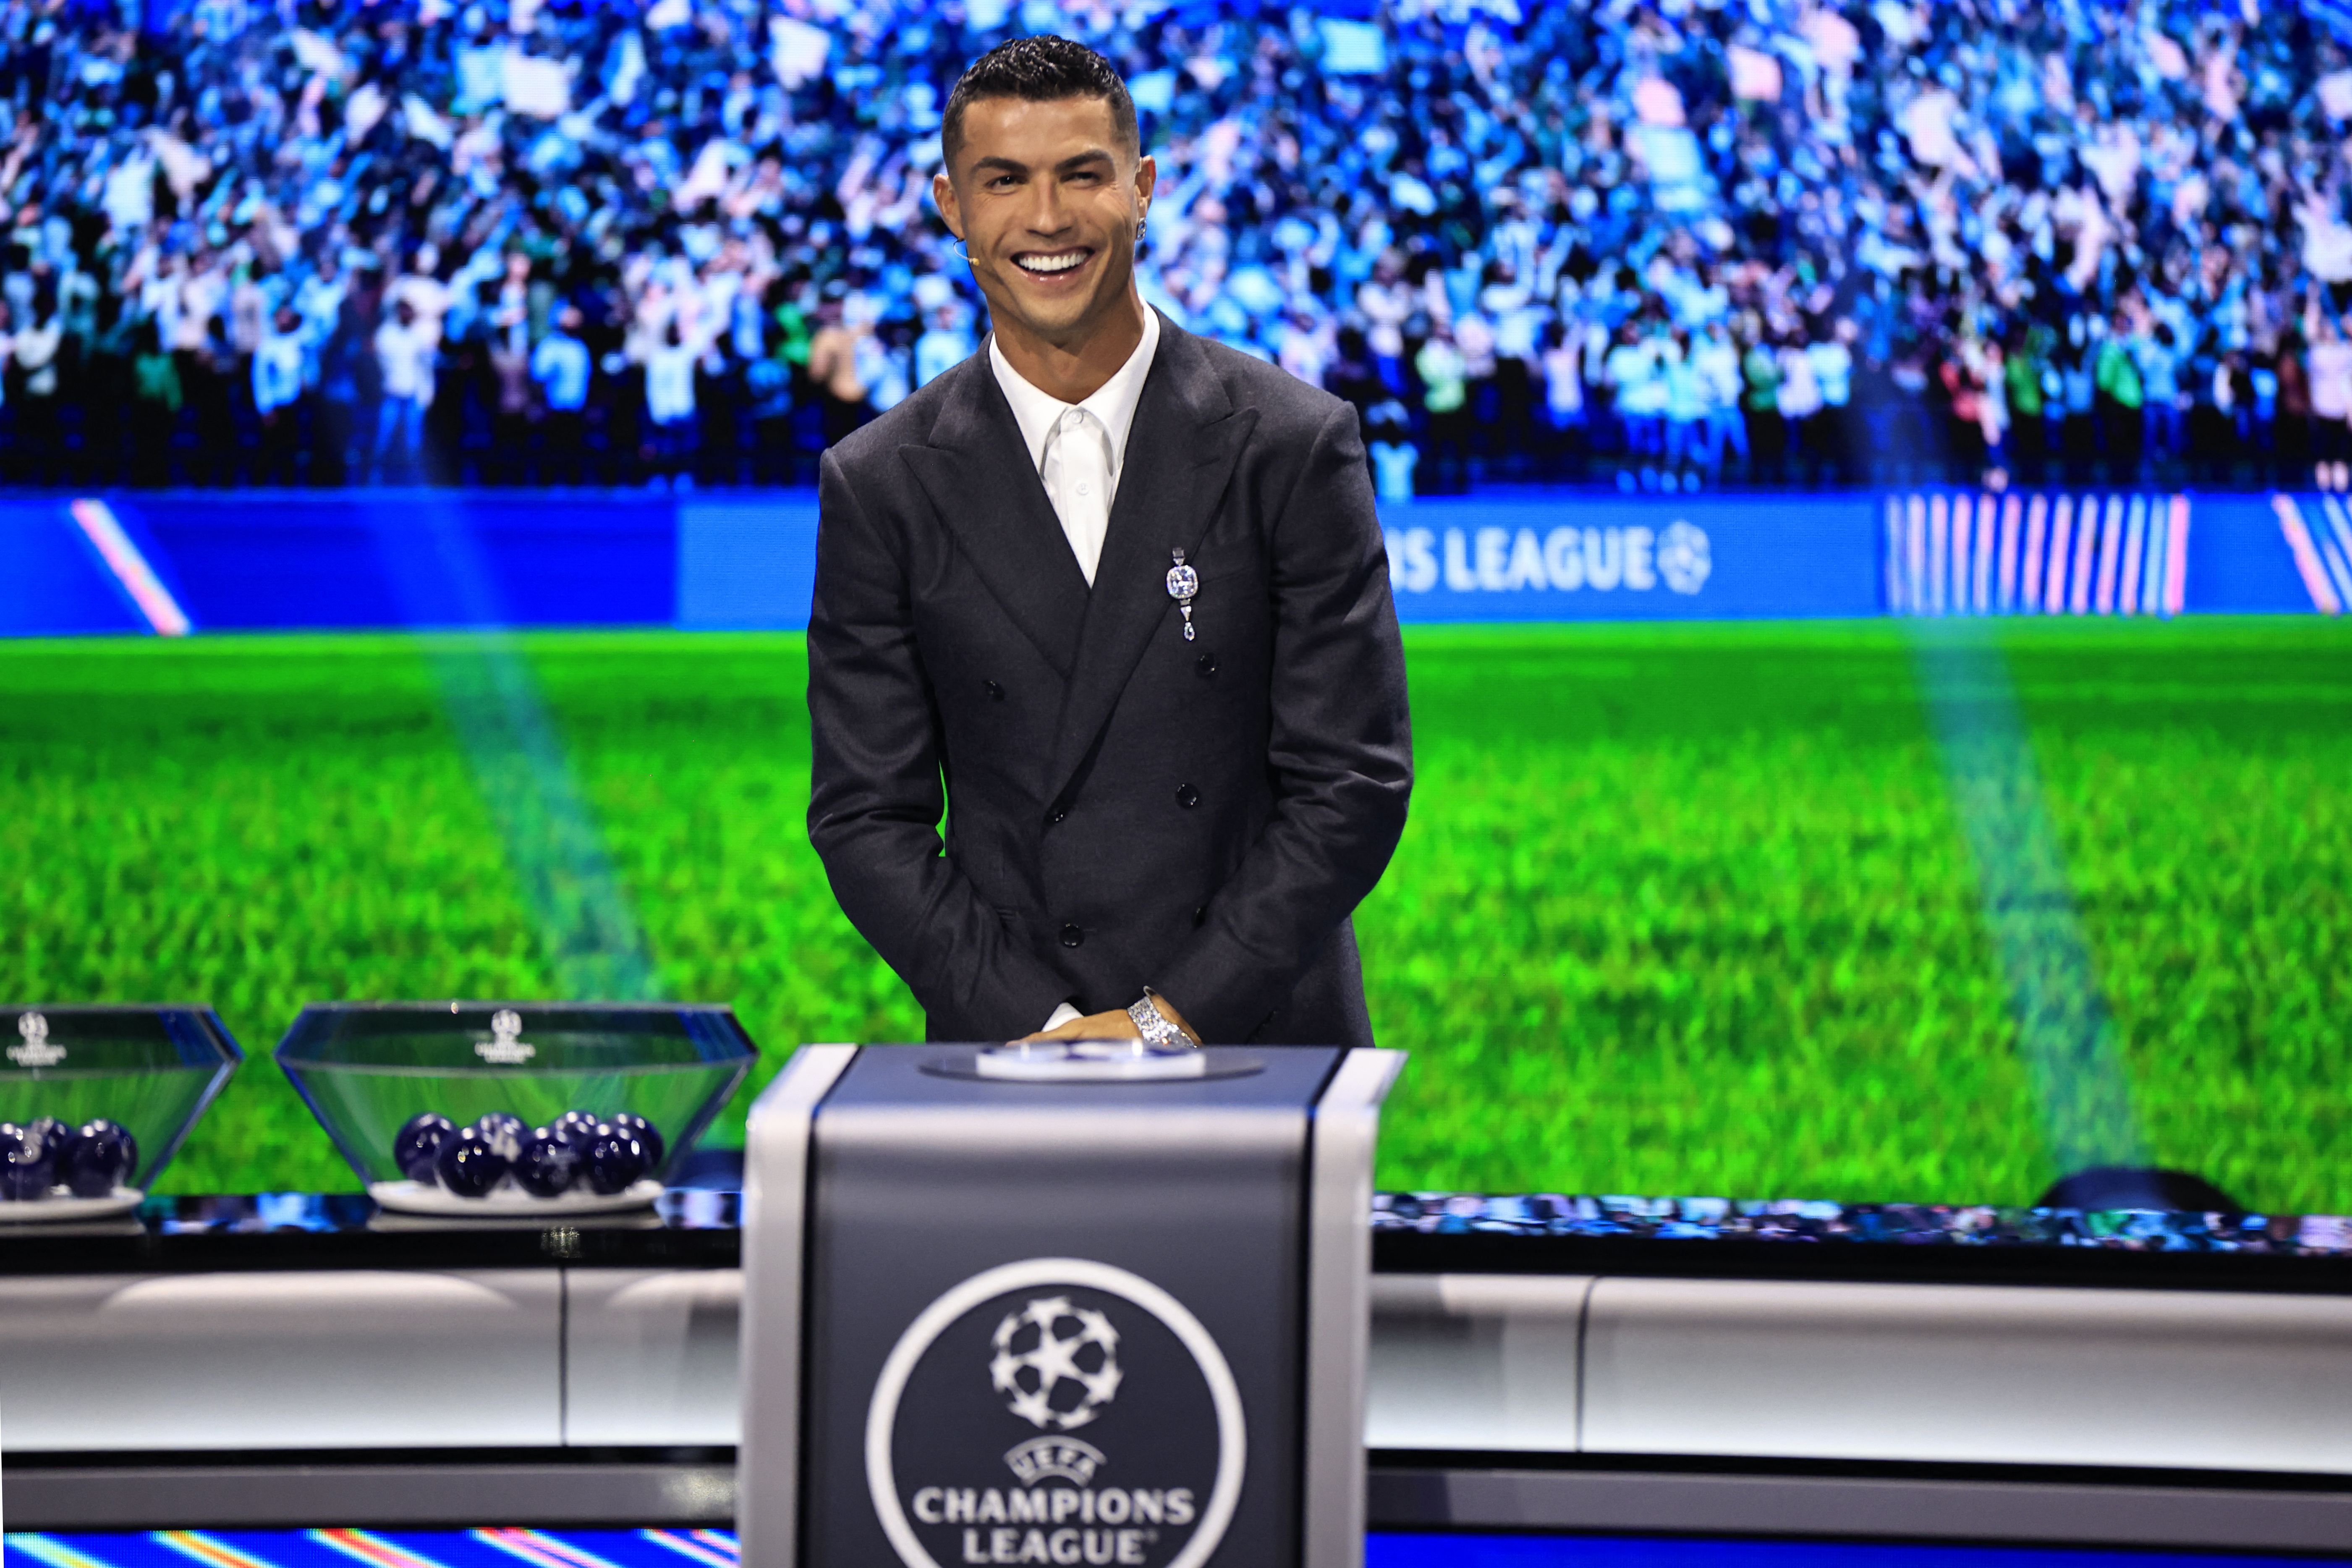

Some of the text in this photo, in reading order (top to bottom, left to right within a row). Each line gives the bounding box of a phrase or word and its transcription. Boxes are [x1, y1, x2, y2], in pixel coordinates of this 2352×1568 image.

[1444, 526, 1656, 590] LEAGUE
[1009, 1446, 1096, 1481] UEFA
[912, 1487, 1196, 1525] CHAMPIONS
[963, 1527, 1146, 1565] LEAGUE
